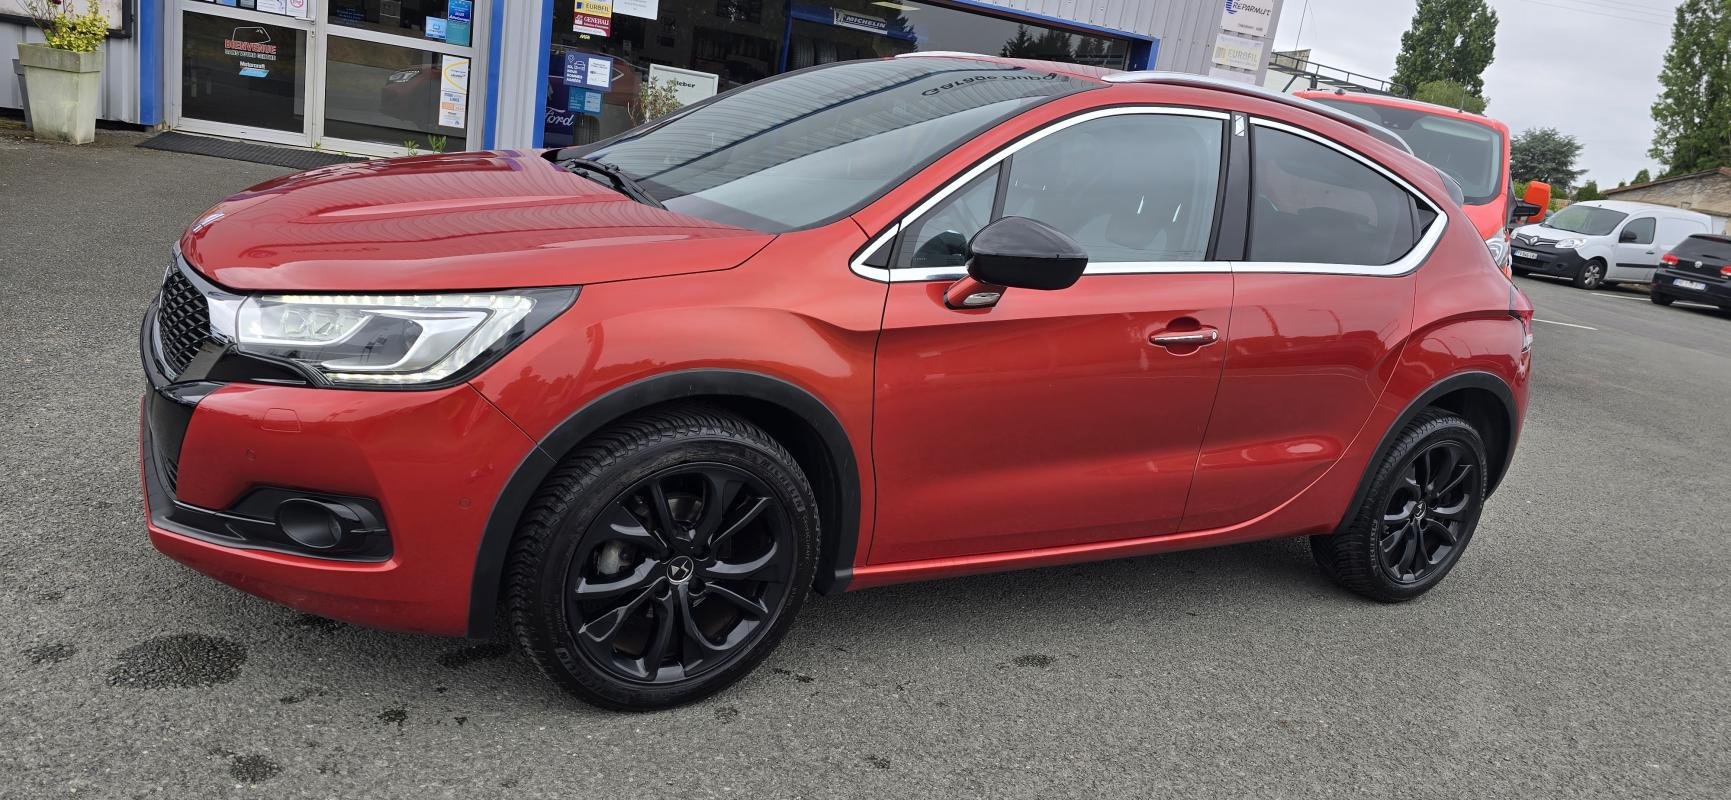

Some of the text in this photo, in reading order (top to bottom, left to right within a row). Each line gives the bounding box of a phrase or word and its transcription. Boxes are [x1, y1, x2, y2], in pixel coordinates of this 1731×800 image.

[585, 2, 610, 12] EUROFIL
[1232, 2, 1271, 16] REPARMUT
[583, 16, 610, 26] GENERALI
[846, 16, 886, 29] MICHELIN
[224, 39, 277, 55] BIENVENUE
[1227, 48, 1258, 63] EUROFIL
[239, 61, 266, 70] Motorcraft
[545, 106, 575, 126] Ford
